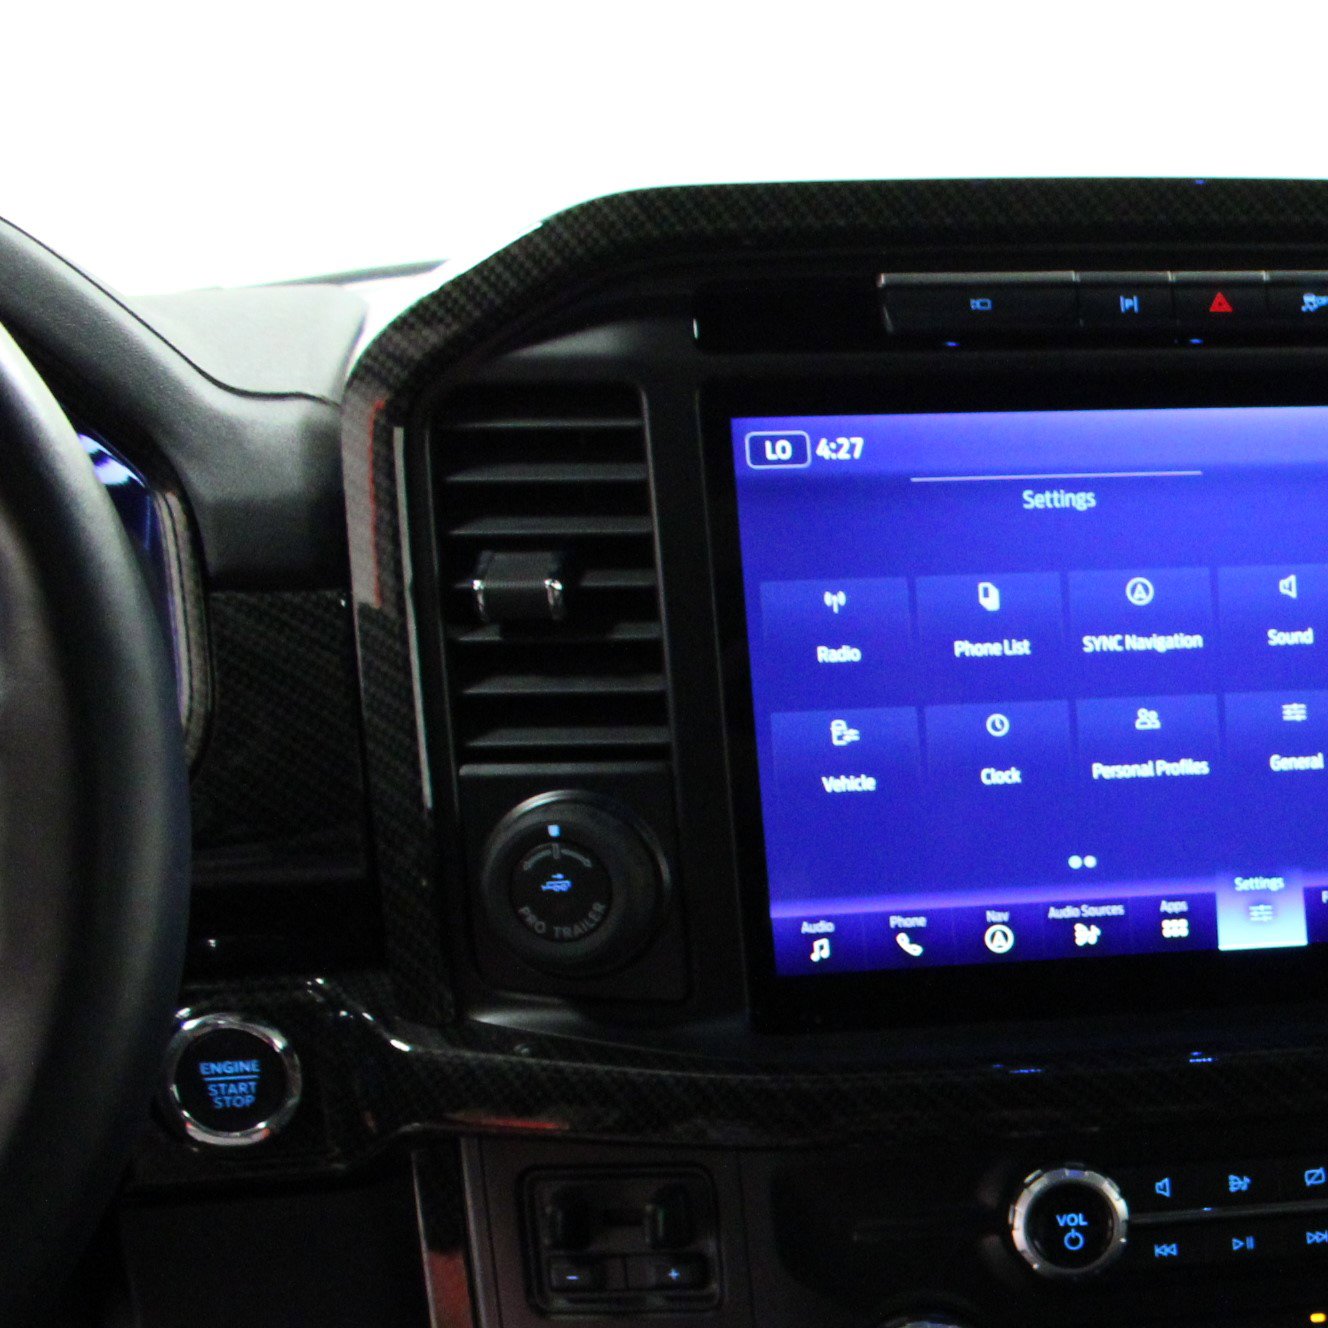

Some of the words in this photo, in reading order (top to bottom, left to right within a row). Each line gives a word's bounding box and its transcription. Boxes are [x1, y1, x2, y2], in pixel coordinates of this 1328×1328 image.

[765, 439, 793, 461] LO
[816, 437, 864, 460] 4:27
[1022, 489, 1096, 511] Settings
[1082, 634, 1123, 654] SYNC
[1125, 632, 1203, 653] Navigation
[1267, 627, 1314, 647] Sound
[817, 646, 861, 663] Radio
[954, 639, 1002, 659] Phone
[1003, 638, 1031, 656] List
[1092, 760, 1154, 780] Personal
[1155, 758, 1210, 777] Profiles
[1269, 753, 1324, 772] General
[822, 774, 876, 793] Vehicle
[981, 767, 1022, 785] Clock
[1234, 875, 1285, 893] Settings
[1048, 905, 1079, 920] Audio
[1080, 902, 1125, 918] Sources
[1159, 899, 1188, 915] Apps
[889, 914, 927, 930] Phone
[986, 909, 1009, 924] Nav
[801, 919, 835, 934] Audio
[200, 1060, 260, 1075] ENGINE
[208, 1082, 257, 1097] START
[214, 1095, 256, 1109] STOP
[1056, 1213, 1088, 1229] VOL
